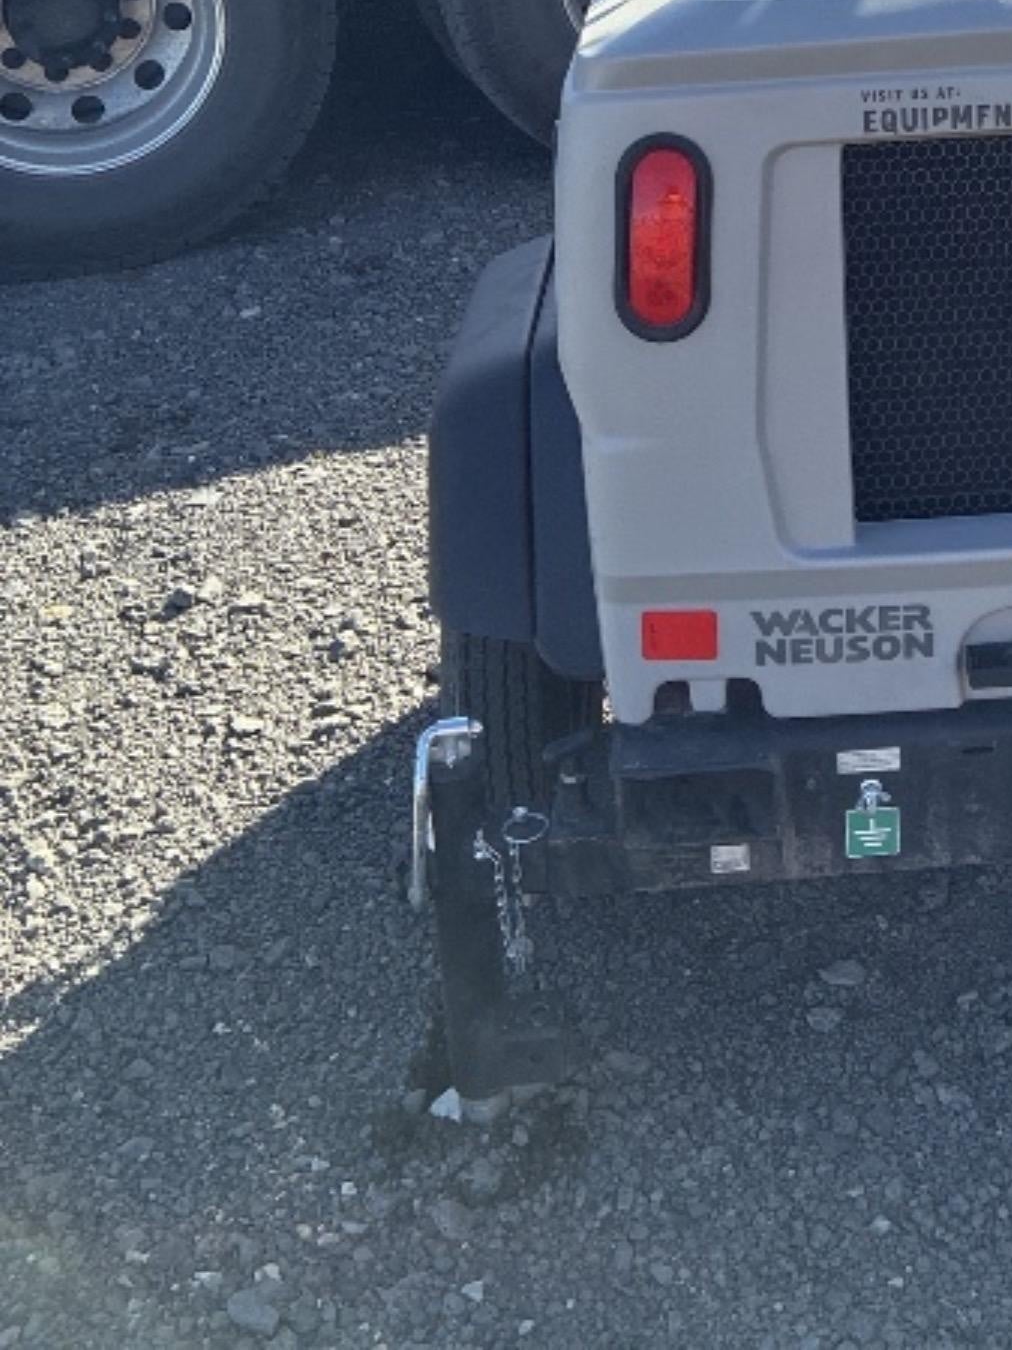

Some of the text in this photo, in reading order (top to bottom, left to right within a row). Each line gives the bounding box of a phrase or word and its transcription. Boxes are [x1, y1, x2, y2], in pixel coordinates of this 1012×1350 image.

[861, 89, 904, 103] VISIT
[749, 603, 934, 637] WACKER
[755, 632, 934, 667] NEUSON
